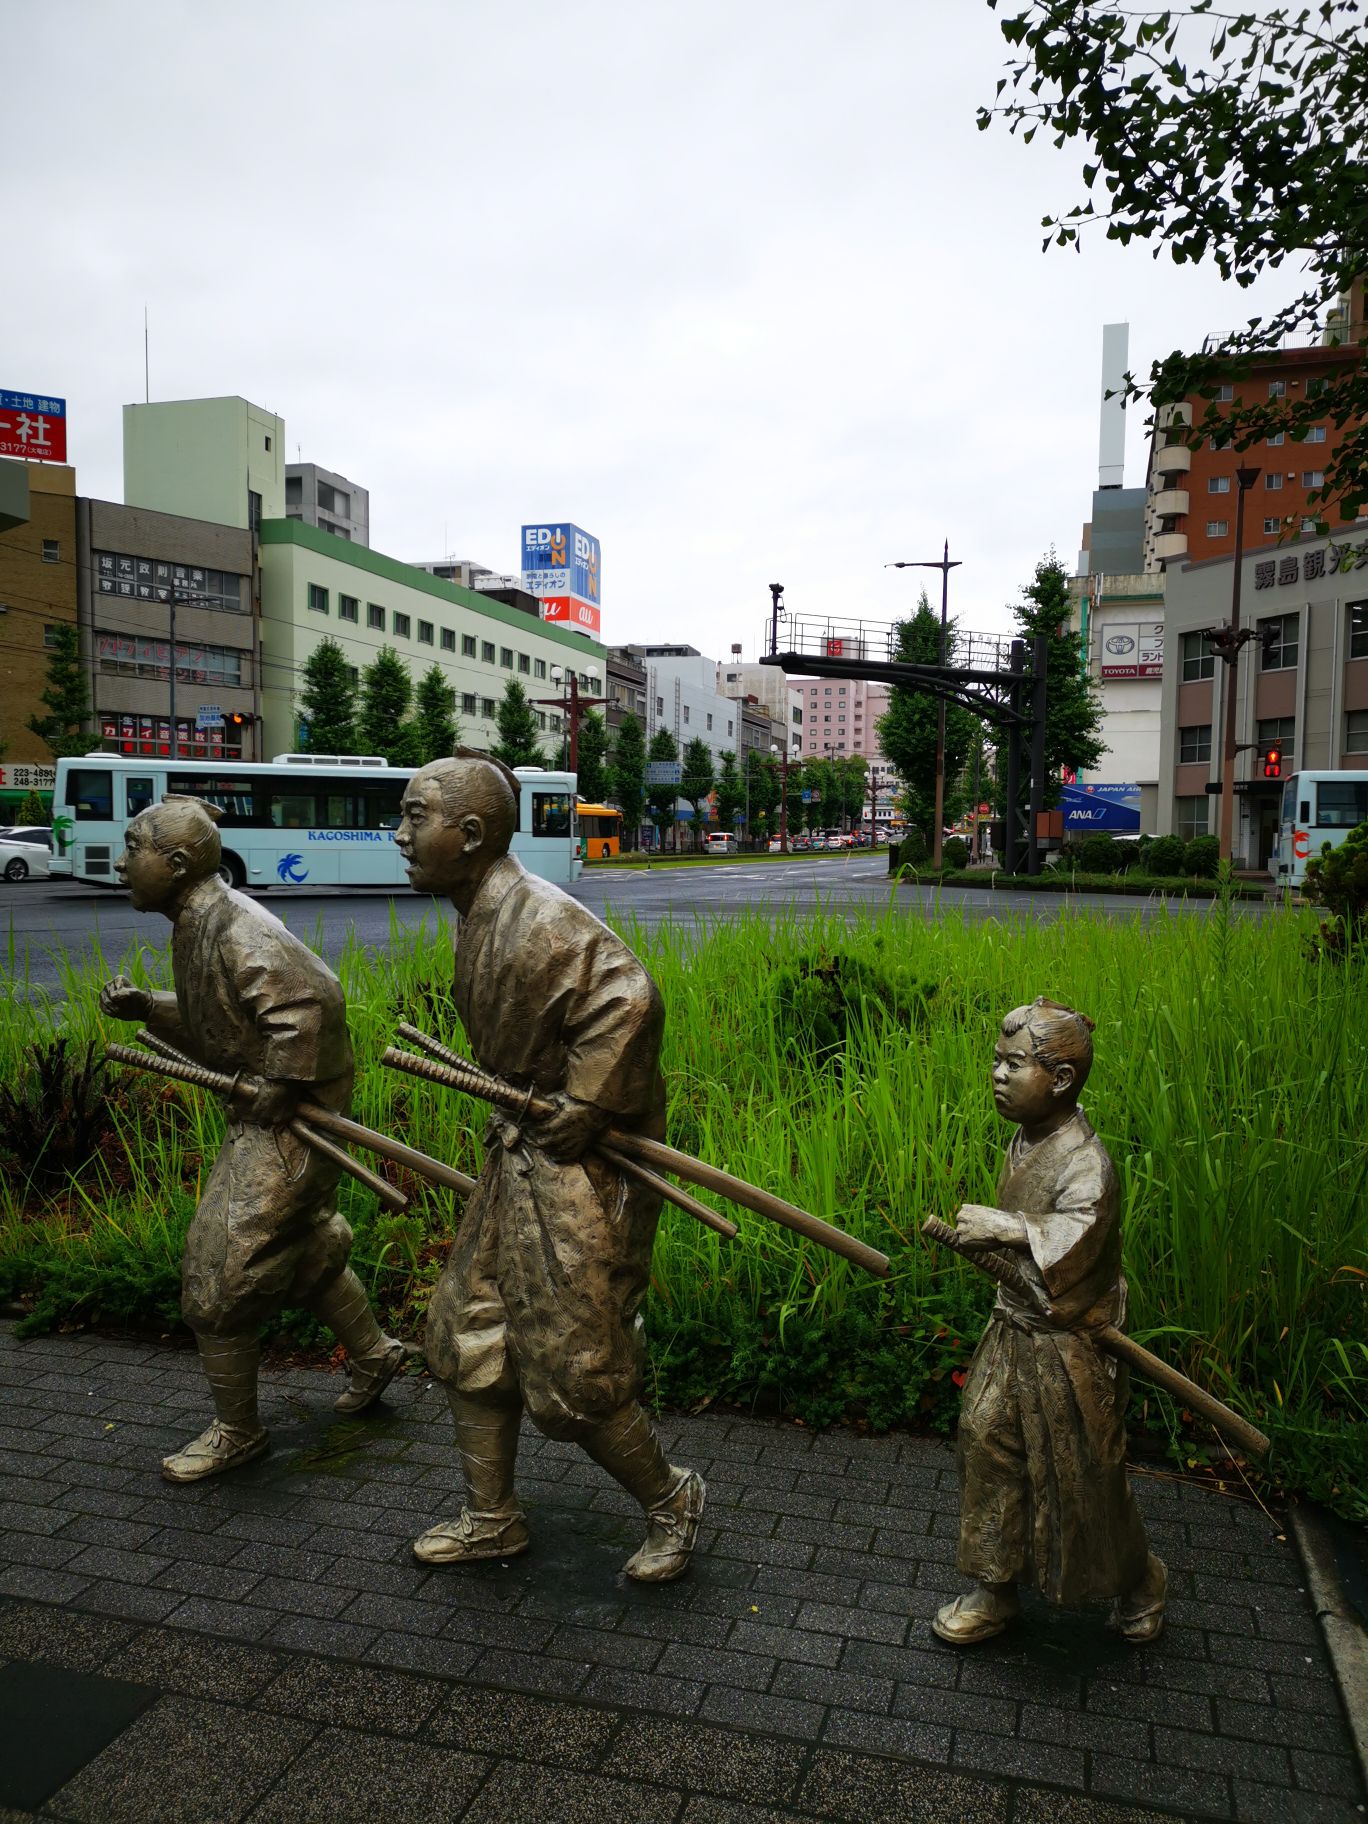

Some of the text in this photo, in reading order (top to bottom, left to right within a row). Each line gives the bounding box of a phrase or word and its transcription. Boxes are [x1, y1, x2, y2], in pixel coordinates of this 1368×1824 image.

[578, 606, 594, 625] au
[1068, 810, 1093, 820] ANA
[307, 831, 382, 841] KAGOSHIMA
